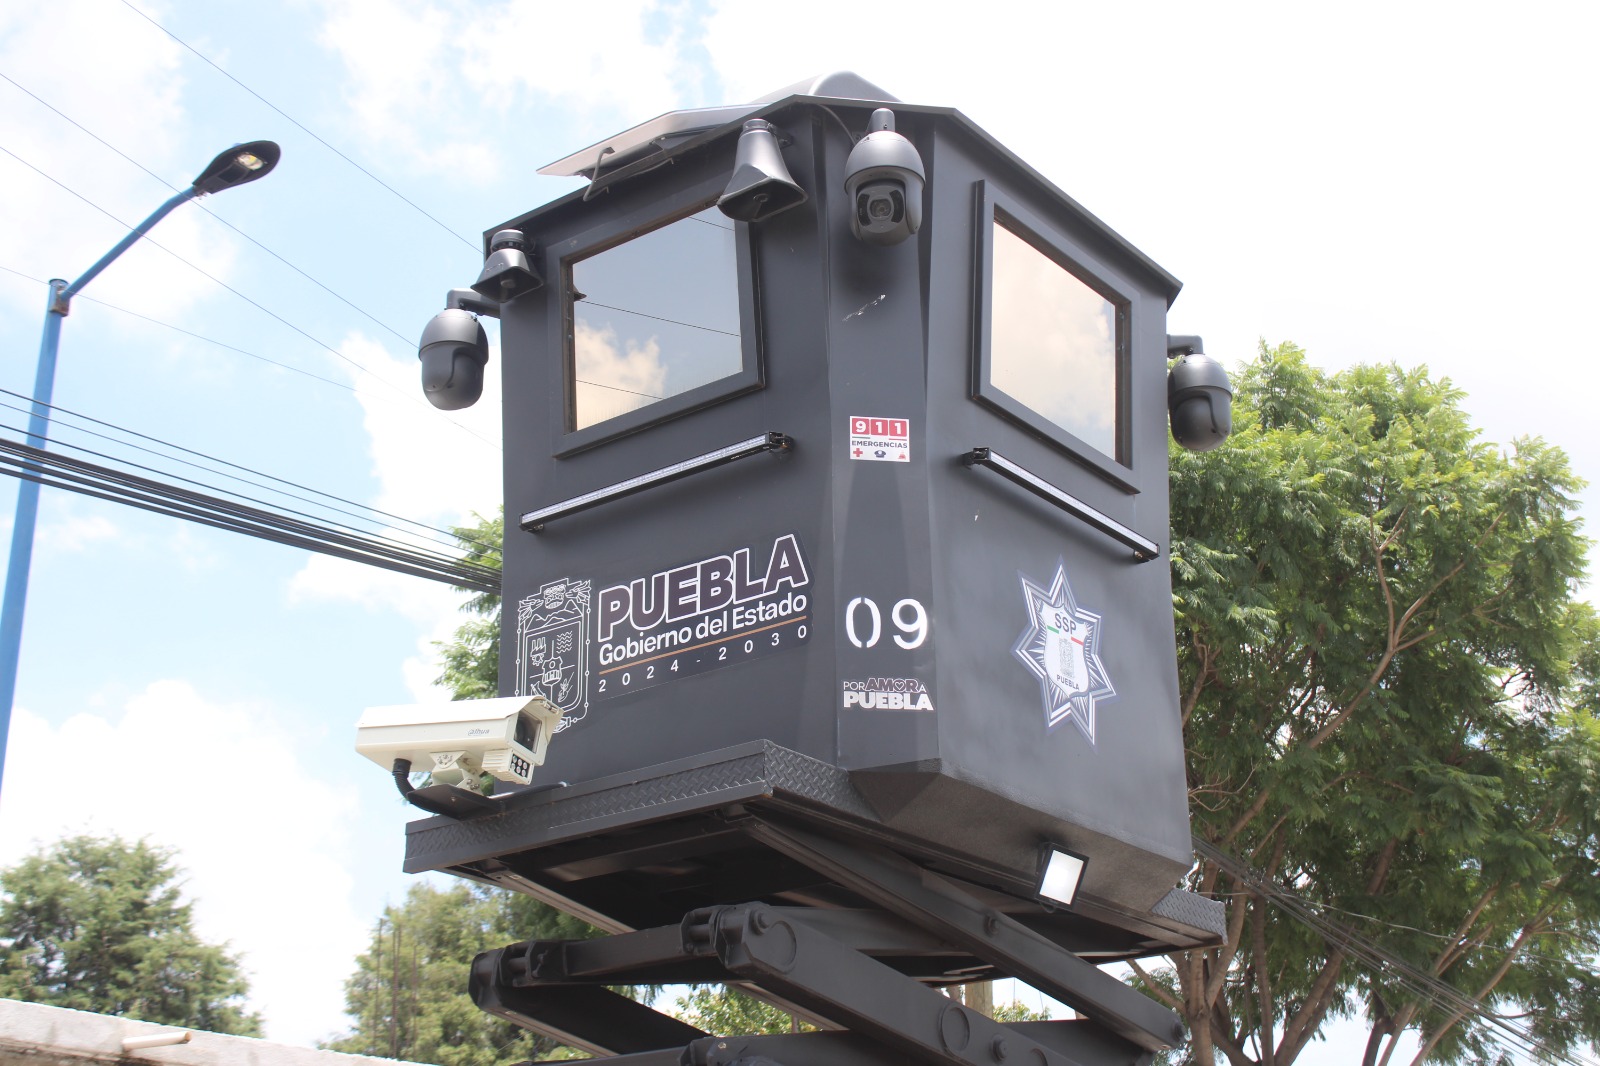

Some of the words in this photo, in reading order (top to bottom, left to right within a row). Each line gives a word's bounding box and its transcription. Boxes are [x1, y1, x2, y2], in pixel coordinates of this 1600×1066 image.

[855, 420, 902, 434] 911
[851, 440, 908, 448] EMERGENCIAS
[598, 533, 809, 643] PUEBLA
[599, 618, 692, 666] Gobierno
[695, 616, 728, 641] del
[732, 593, 807, 630] Estado
[845, 597, 928, 650] 09
[1054, 613, 1077, 635] SSP
[843, 681, 866, 691] POR
[864, 678, 920, 693] AMOR
[918, 684, 927, 693] A
[1056, 674, 1080, 691] PUEBLA
[843, 691, 935, 711] PUEBLA
